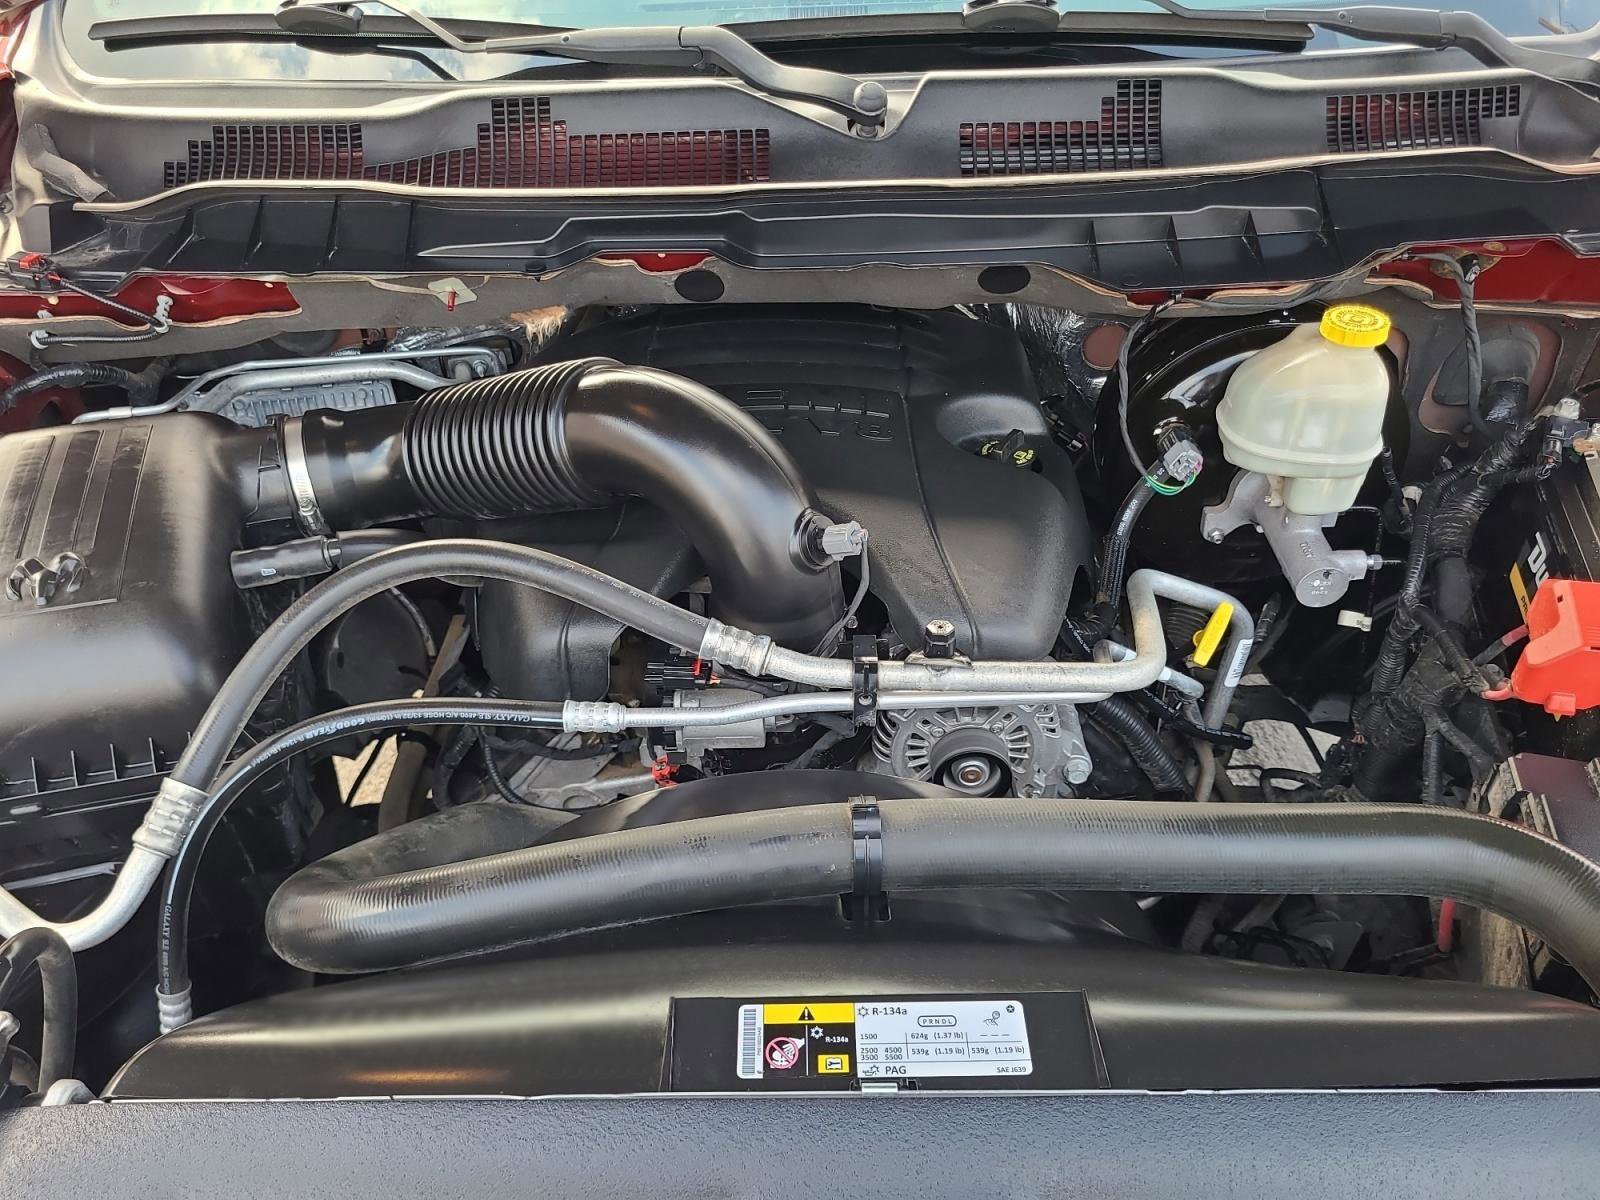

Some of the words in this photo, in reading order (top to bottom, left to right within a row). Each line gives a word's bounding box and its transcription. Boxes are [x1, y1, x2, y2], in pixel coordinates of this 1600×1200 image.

[496, 713, 530, 722] GALAXY
[305, 717, 366, 739] GOODYEAR
[872, 1006, 908, 1016] R-134a
[911, 1032, 929, 1041] 624g
[934, 1032, 952, 1040] (1.37
[953, 1032, 964, 1040] lb)
[911, 1048, 930, 1056] 539g
[935, 1048, 953, 1056] (1.19
[971, 1047, 990, 1055] 539g
[1014, 1046, 1025, 1054] lb)
[885, 1065, 907, 1075] PAG
